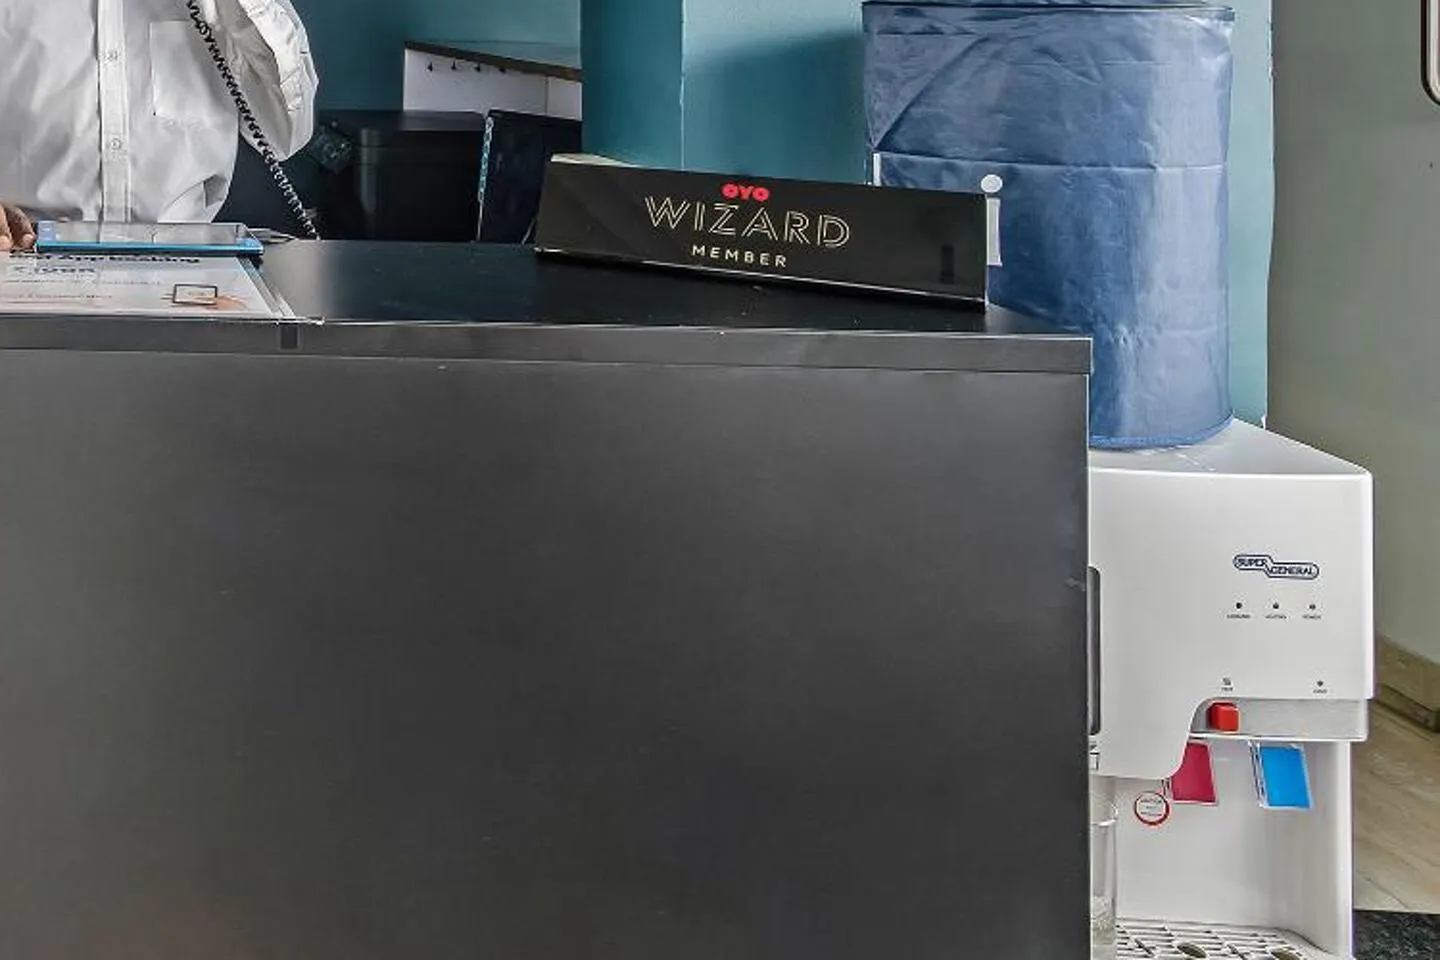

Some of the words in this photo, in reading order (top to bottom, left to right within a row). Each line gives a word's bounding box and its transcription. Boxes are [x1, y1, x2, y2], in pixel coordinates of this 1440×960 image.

[721, 182, 770, 202] OYO
[644, 196, 851, 248] WIZARD
[692, 244, 787, 268] MEMBER
